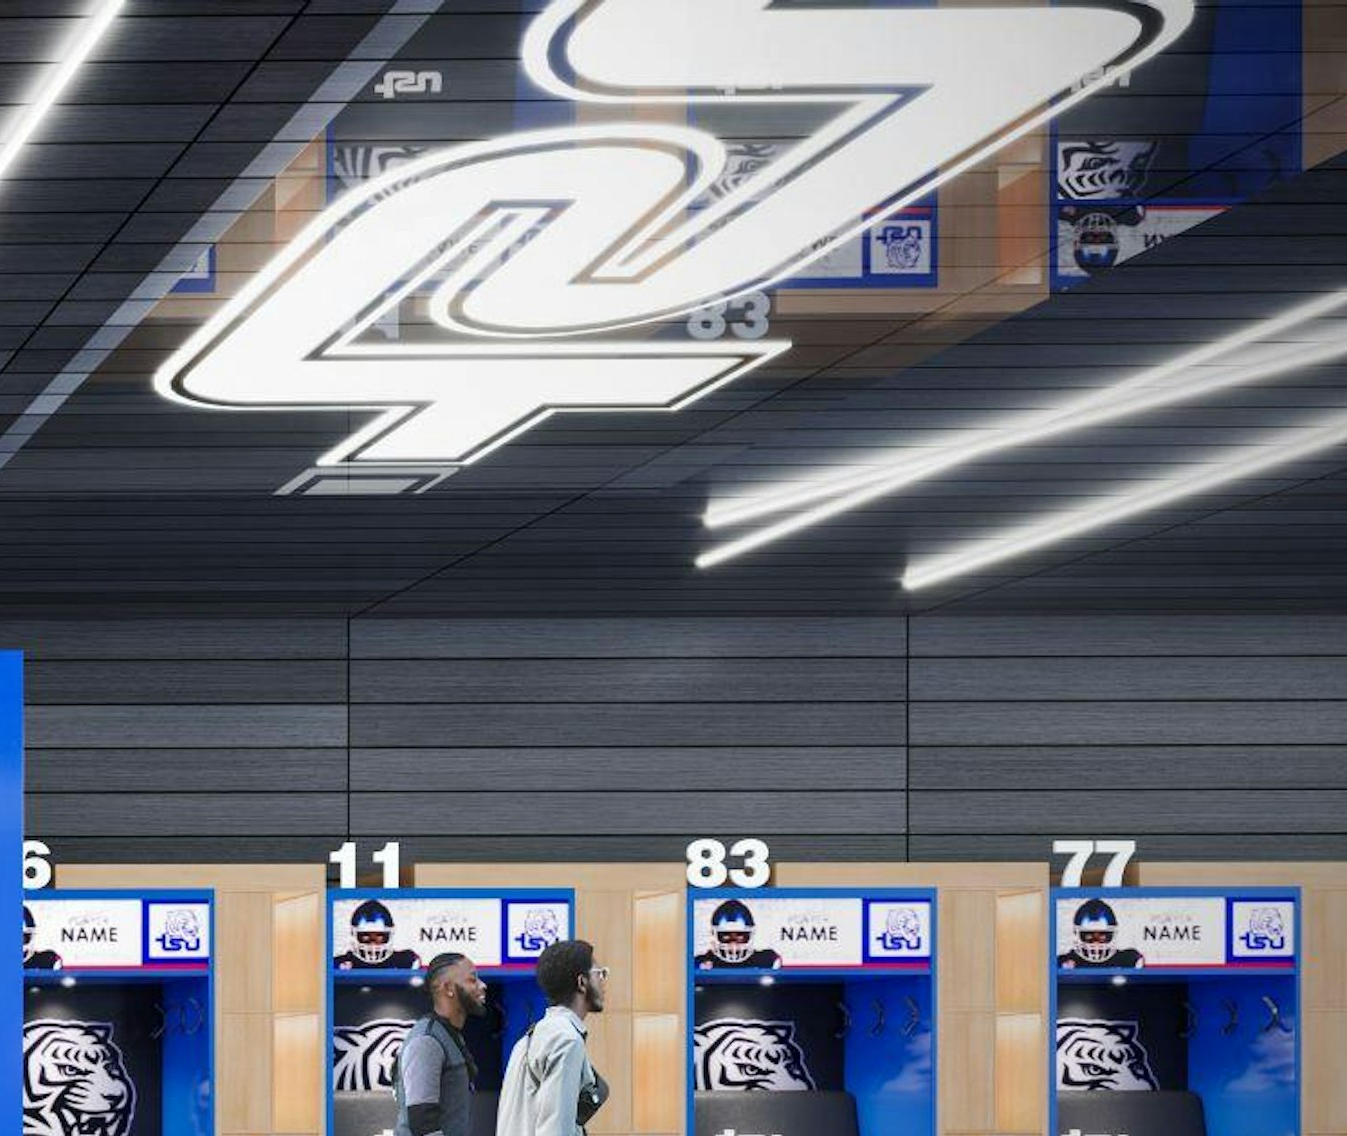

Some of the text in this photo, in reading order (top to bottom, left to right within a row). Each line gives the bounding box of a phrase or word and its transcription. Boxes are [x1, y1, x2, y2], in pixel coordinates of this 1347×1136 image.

[24, 840, 52, 889] 6
[329, 841, 400, 888] 11
[686, 838, 770, 888] 83
[1051, 840, 1136, 887] 77
[60, 927, 118, 942] NAME
[419, 926, 477, 942] NAME
[780, 926, 838, 941] NAME
[1143, 925, 1202, 941] NAME
